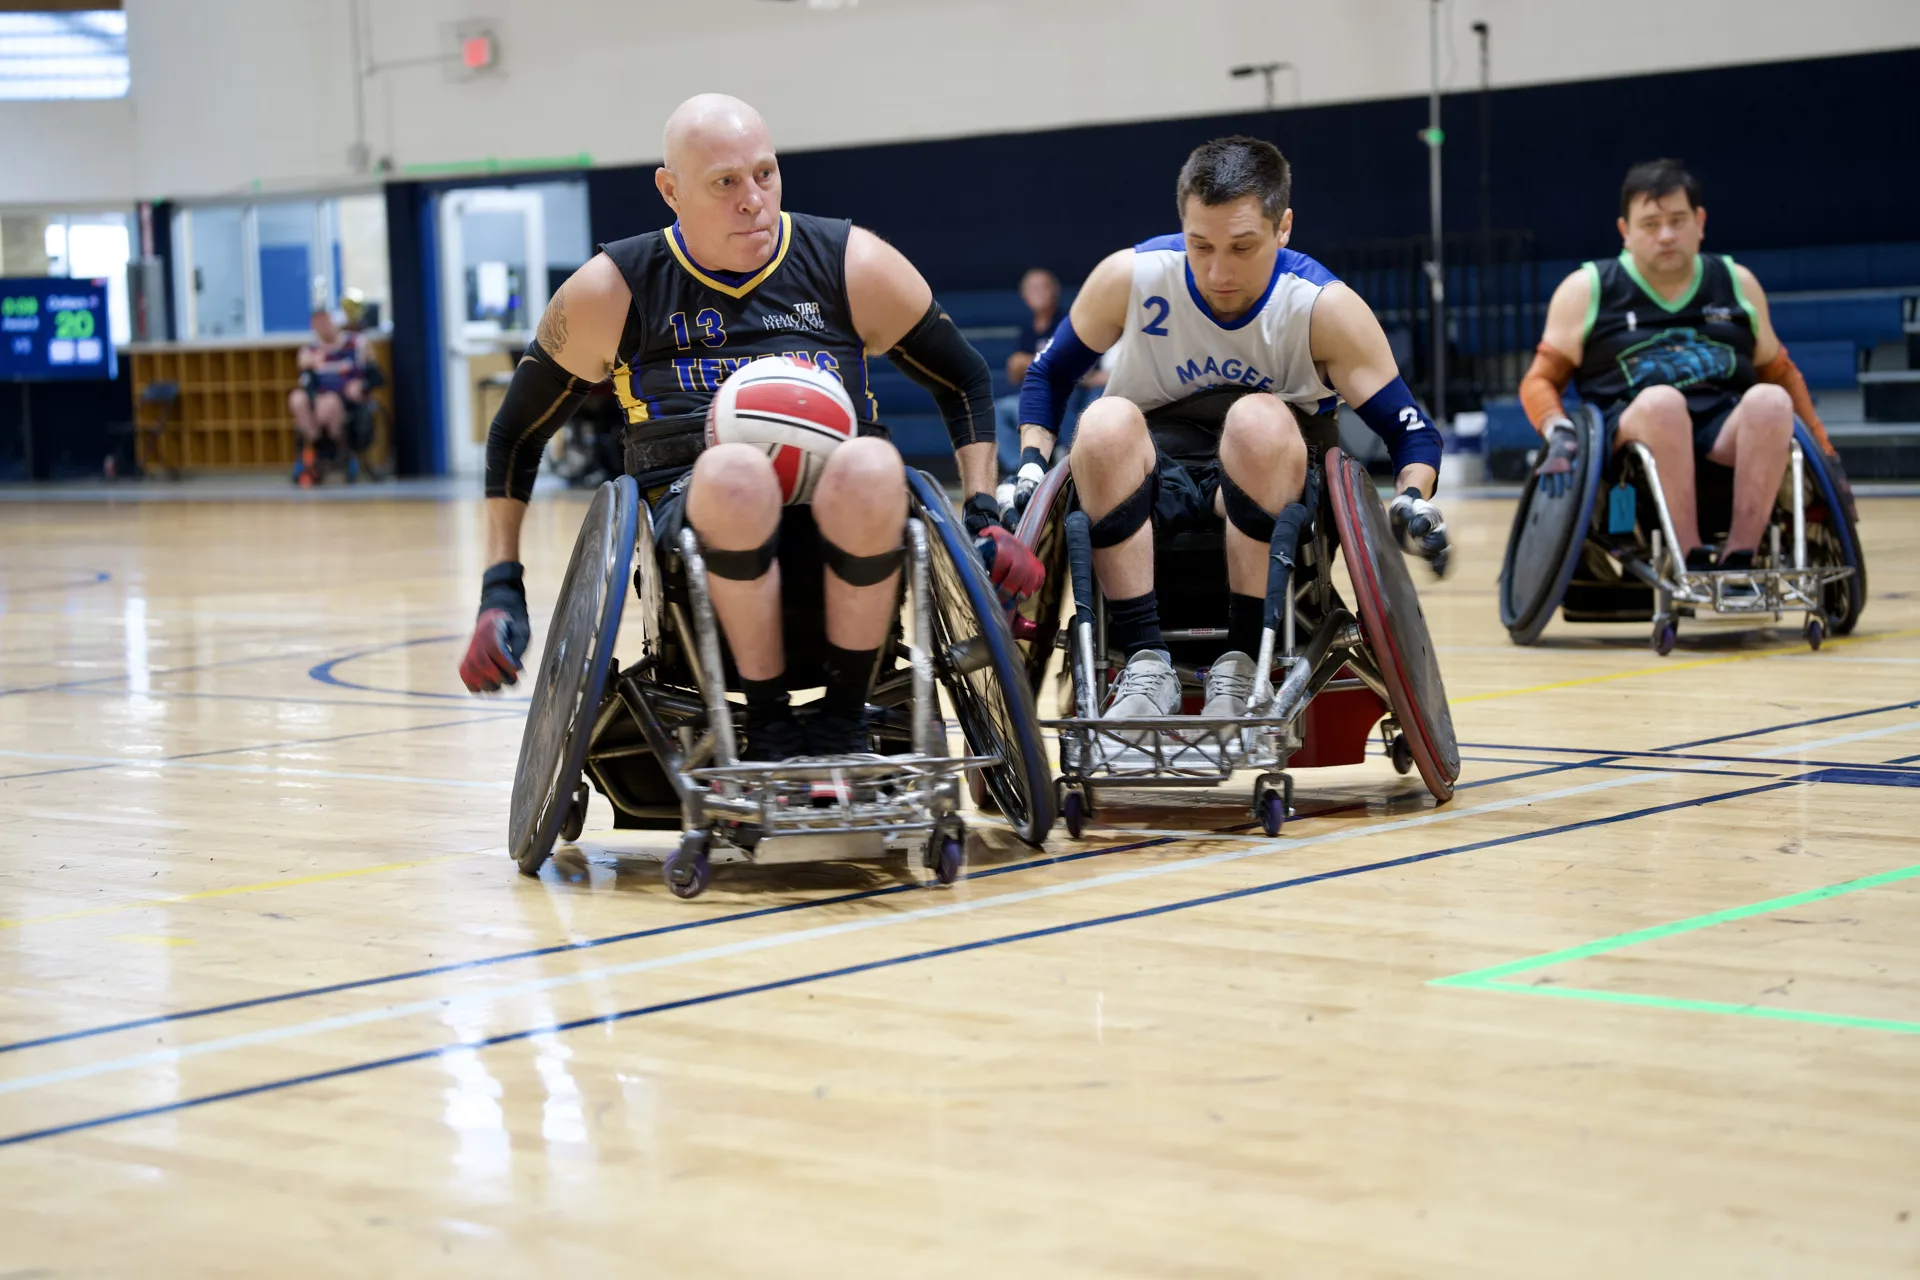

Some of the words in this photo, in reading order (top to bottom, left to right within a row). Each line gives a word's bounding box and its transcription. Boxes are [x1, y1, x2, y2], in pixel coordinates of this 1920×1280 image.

[55, 309, 95, 339] 20
[793, 302, 820, 315] TIRR
[1141, 295, 1170, 337] 2
[669, 307, 728, 351] 13
[671, 350, 844, 392] TES
[1175, 356, 1274, 390] MAGEE
[1399, 406, 1426, 431] 2
